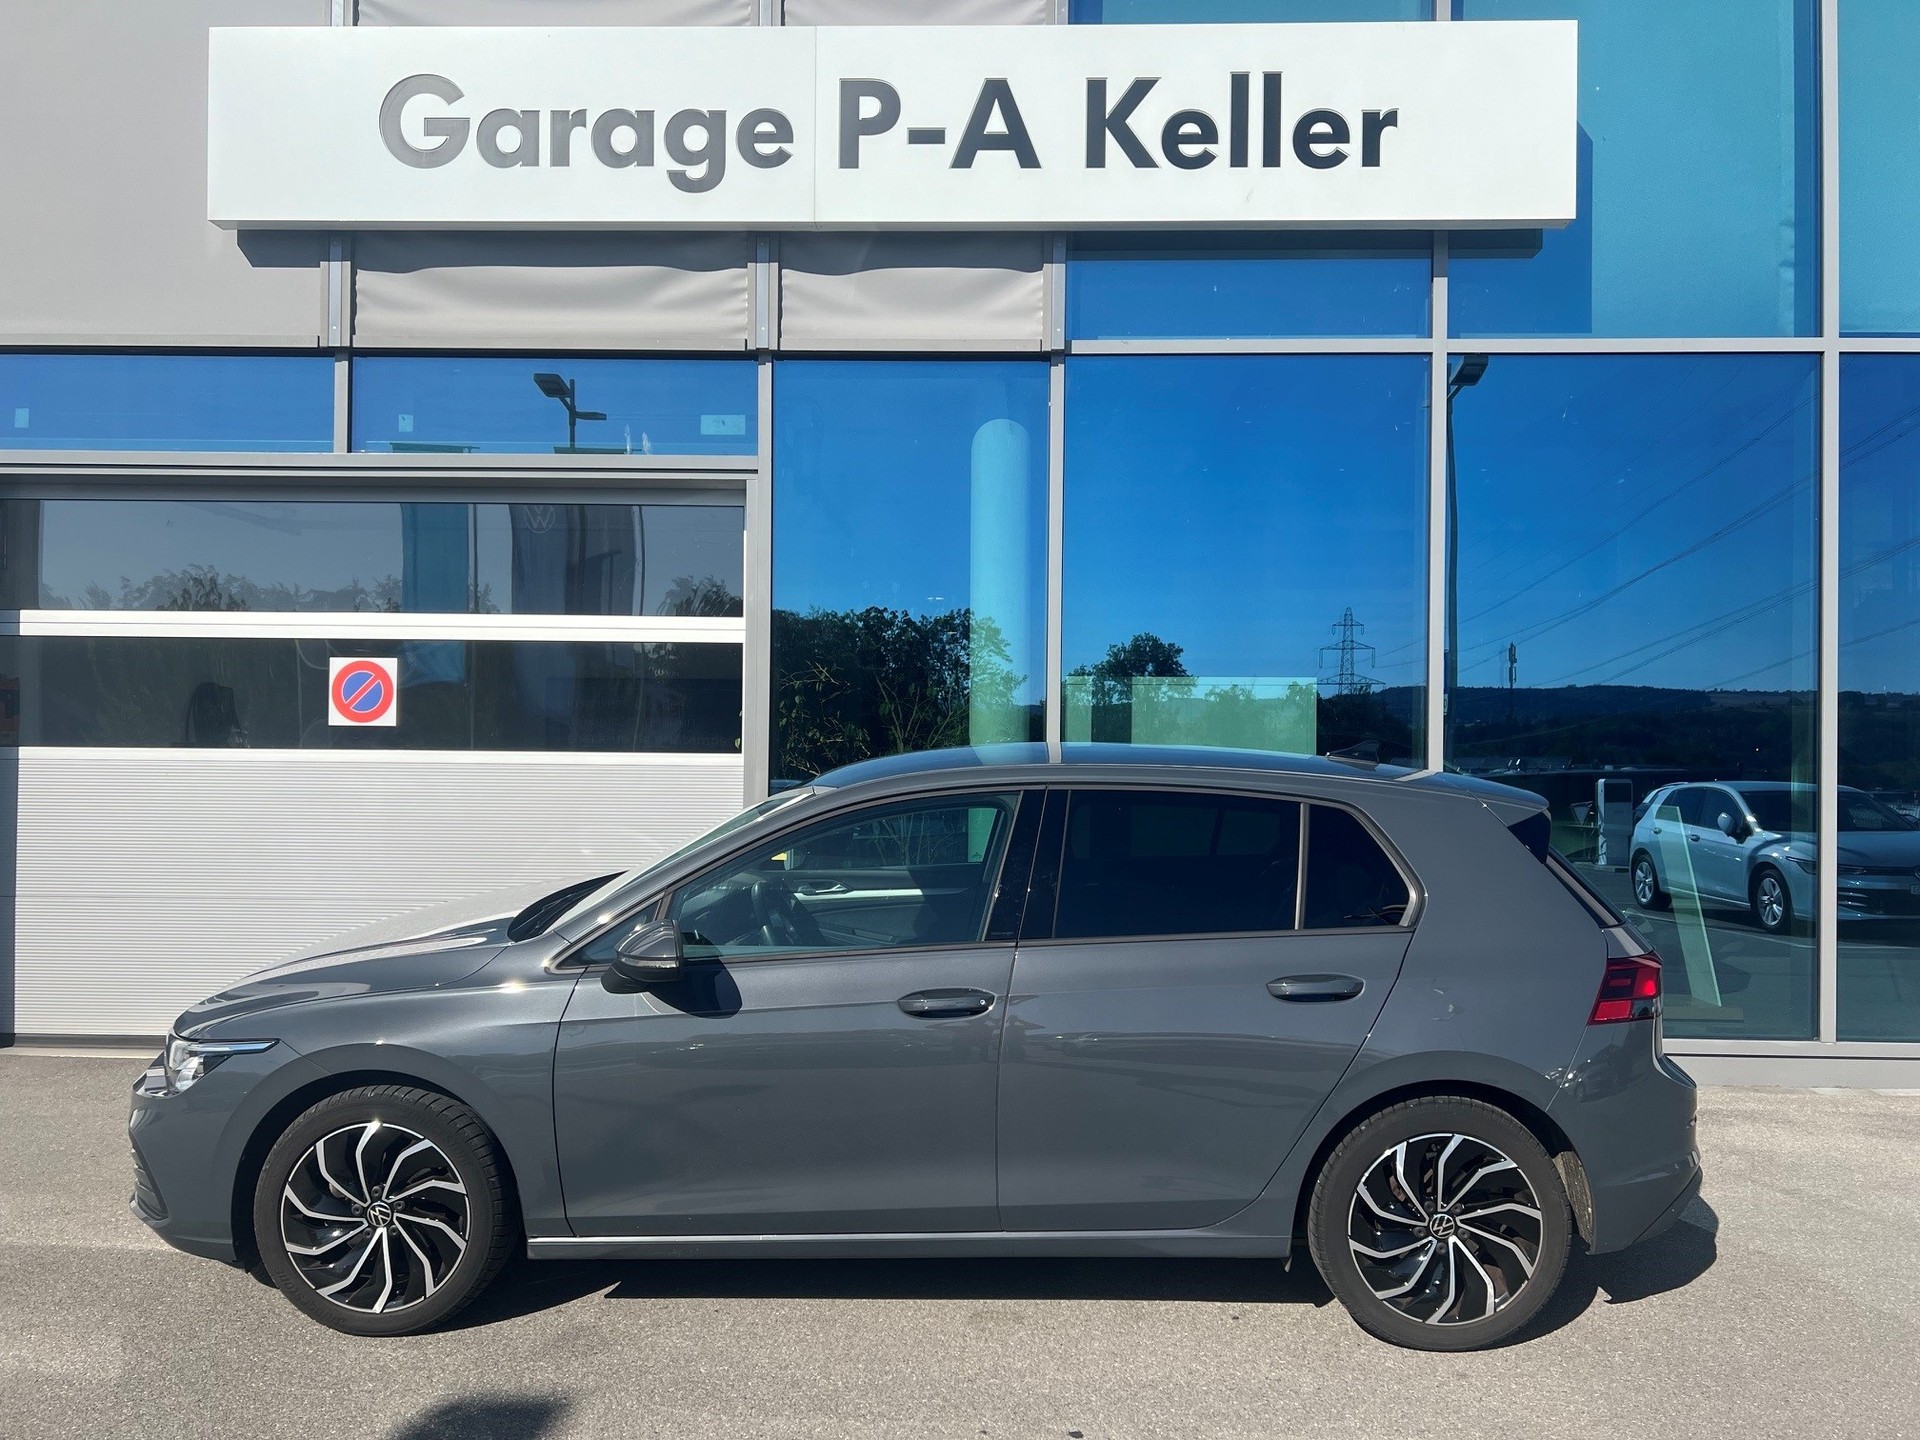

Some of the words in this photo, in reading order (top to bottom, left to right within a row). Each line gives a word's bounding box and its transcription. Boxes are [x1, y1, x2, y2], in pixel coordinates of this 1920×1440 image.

[378, 73, 794, 194] Garage
[838, 77, 1043, 170] P-A
[1085, 70, 1400, 171] Keller
